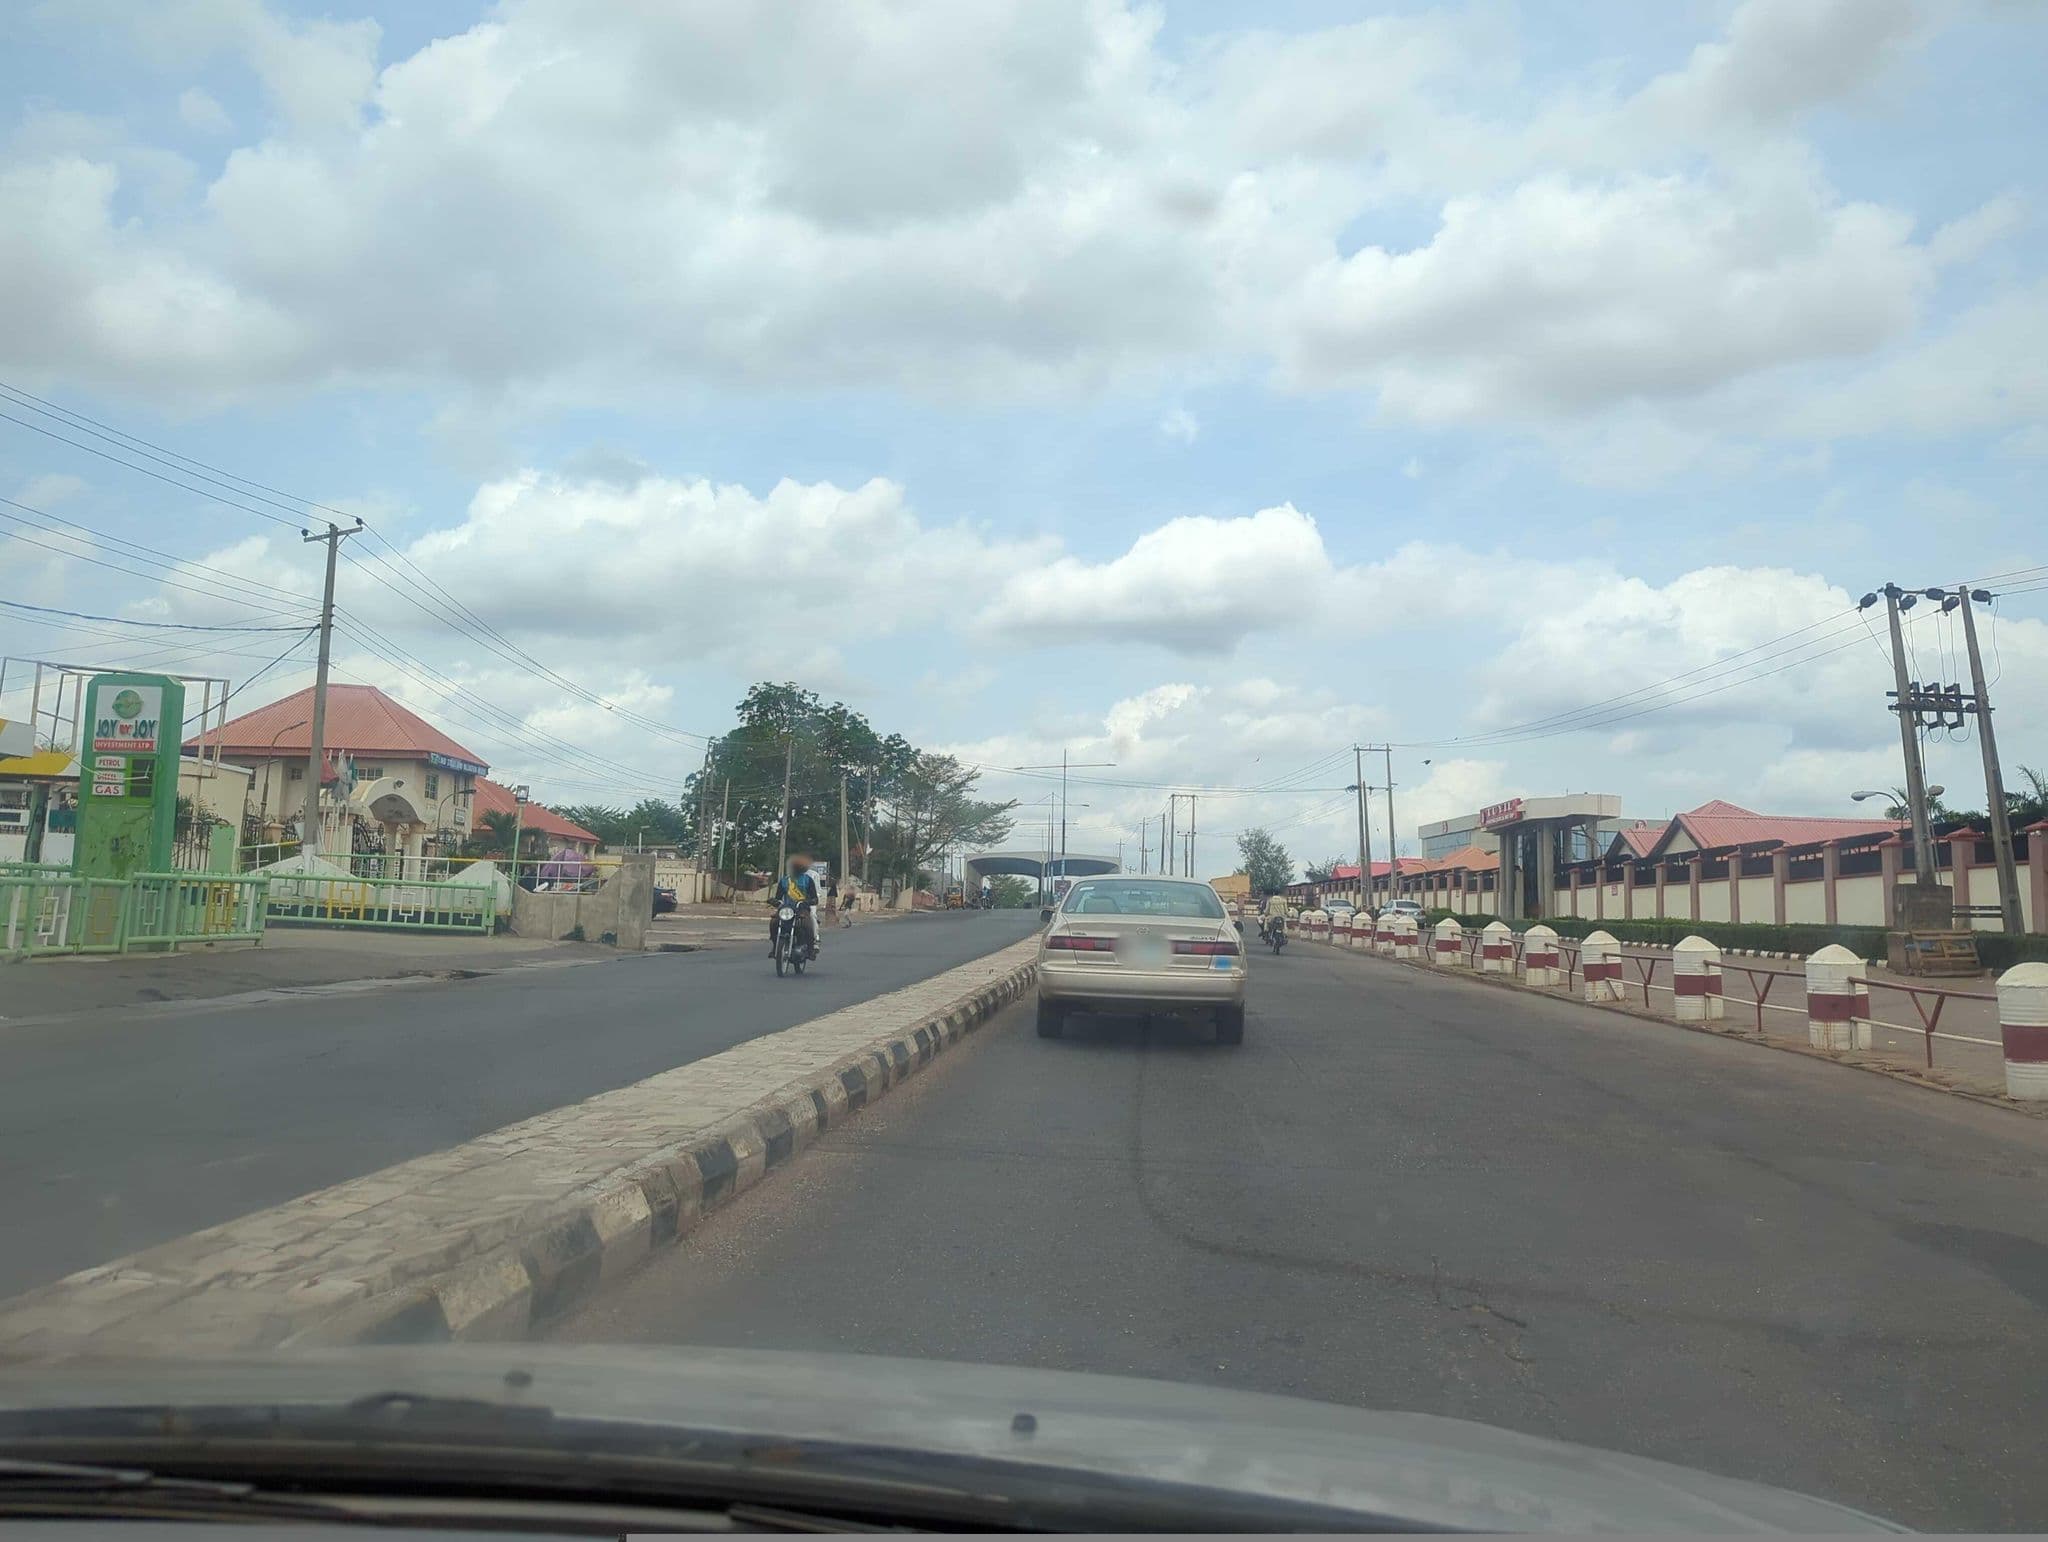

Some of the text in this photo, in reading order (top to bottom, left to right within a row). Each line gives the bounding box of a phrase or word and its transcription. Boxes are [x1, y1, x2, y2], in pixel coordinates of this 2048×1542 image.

[96, 719, 117, 737] JOY
[133, 719, 156, 738] JOY
[95, 740, 137, 749] INVESTMENT
[98, 759, 120, 767] PETROL
[95, 785, 120, 795] GAS
